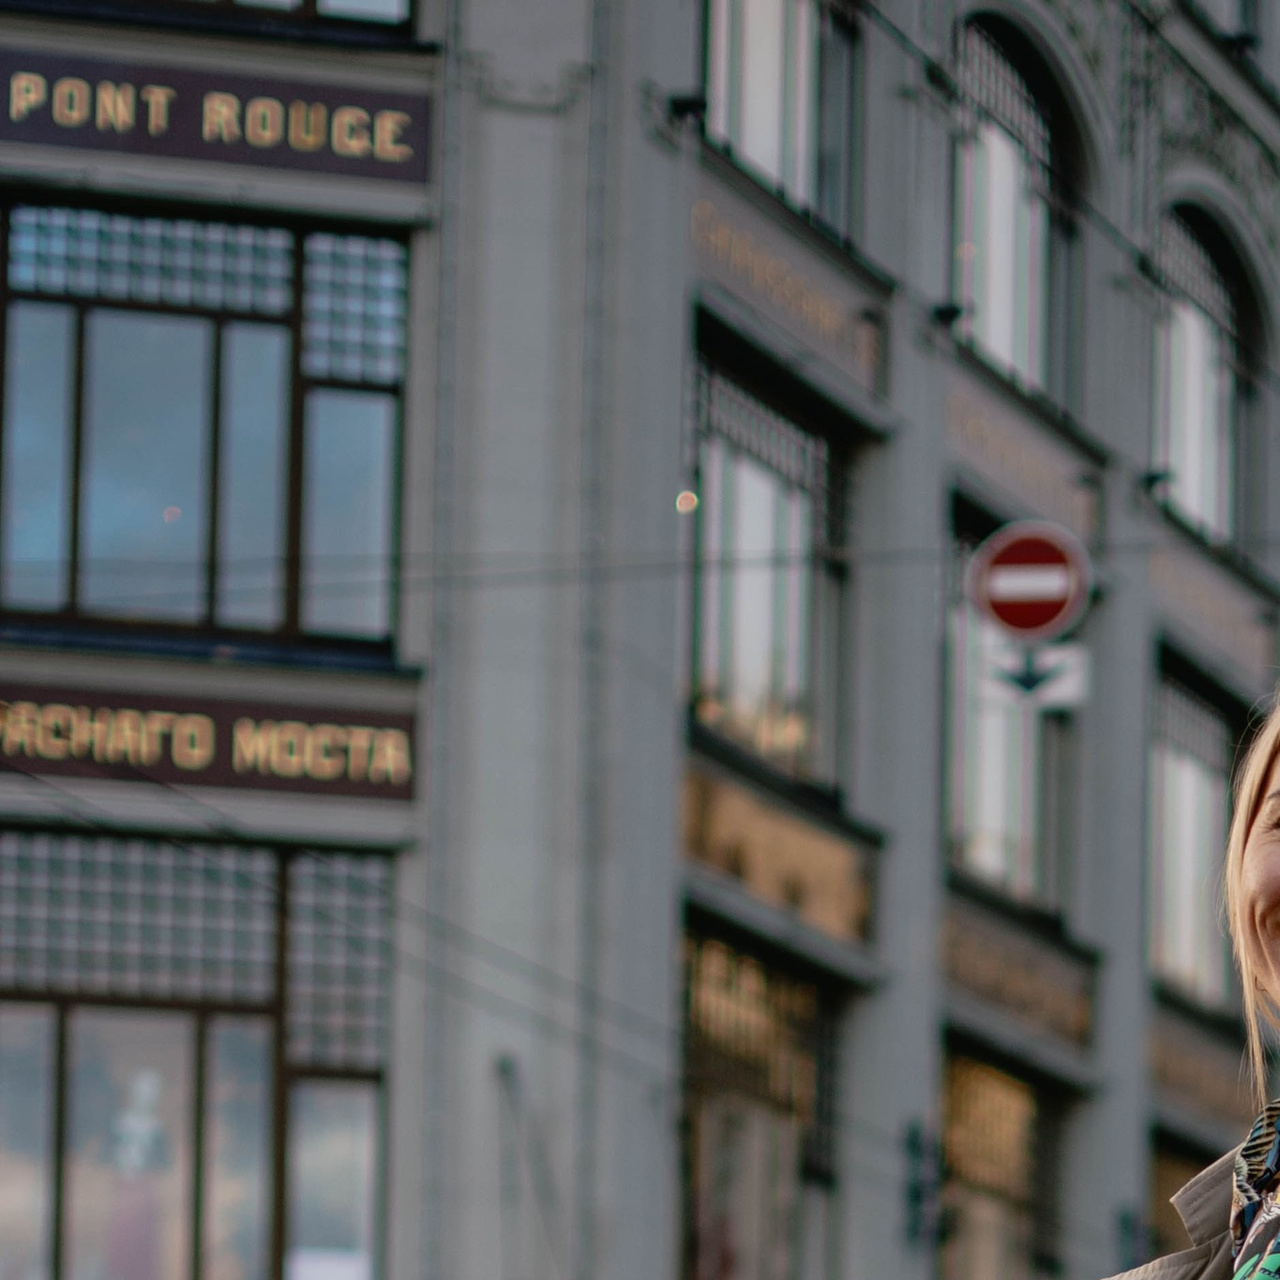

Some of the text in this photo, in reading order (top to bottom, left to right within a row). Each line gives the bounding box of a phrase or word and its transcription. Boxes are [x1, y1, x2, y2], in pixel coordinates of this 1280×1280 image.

[9, 71, 414, 163] PONT ROUGE
[0, 701, 413, 786] АСНАГО МОСТА
